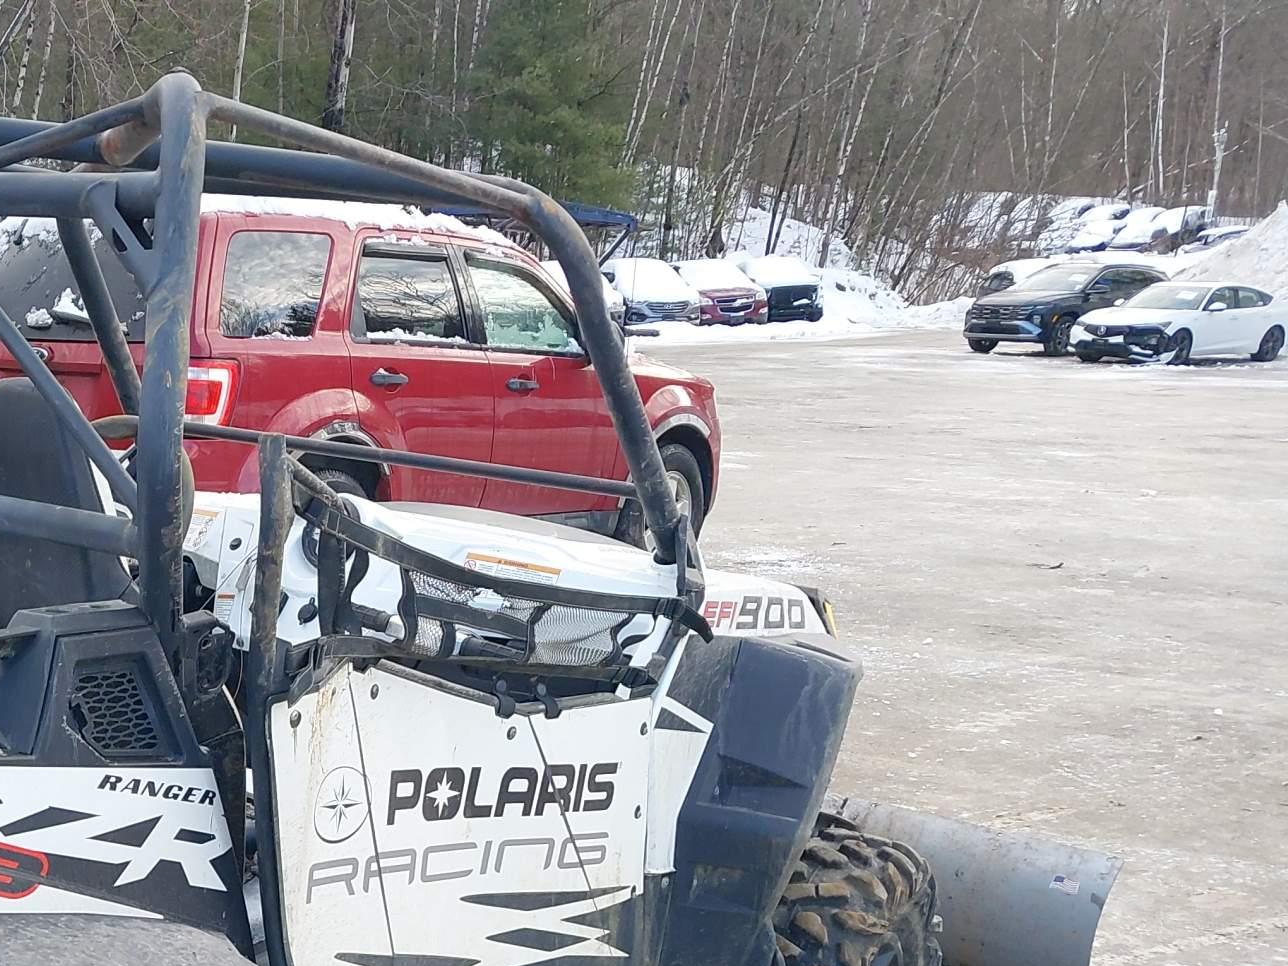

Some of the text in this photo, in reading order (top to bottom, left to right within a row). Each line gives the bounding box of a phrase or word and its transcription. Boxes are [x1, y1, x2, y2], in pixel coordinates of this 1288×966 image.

[703, 596, 806, 630] EFI 900
[97, 774, 217, 806] RANGER
[386, 762, 619, 826] POLARIS
[305, 832, 610, 905] RACING
